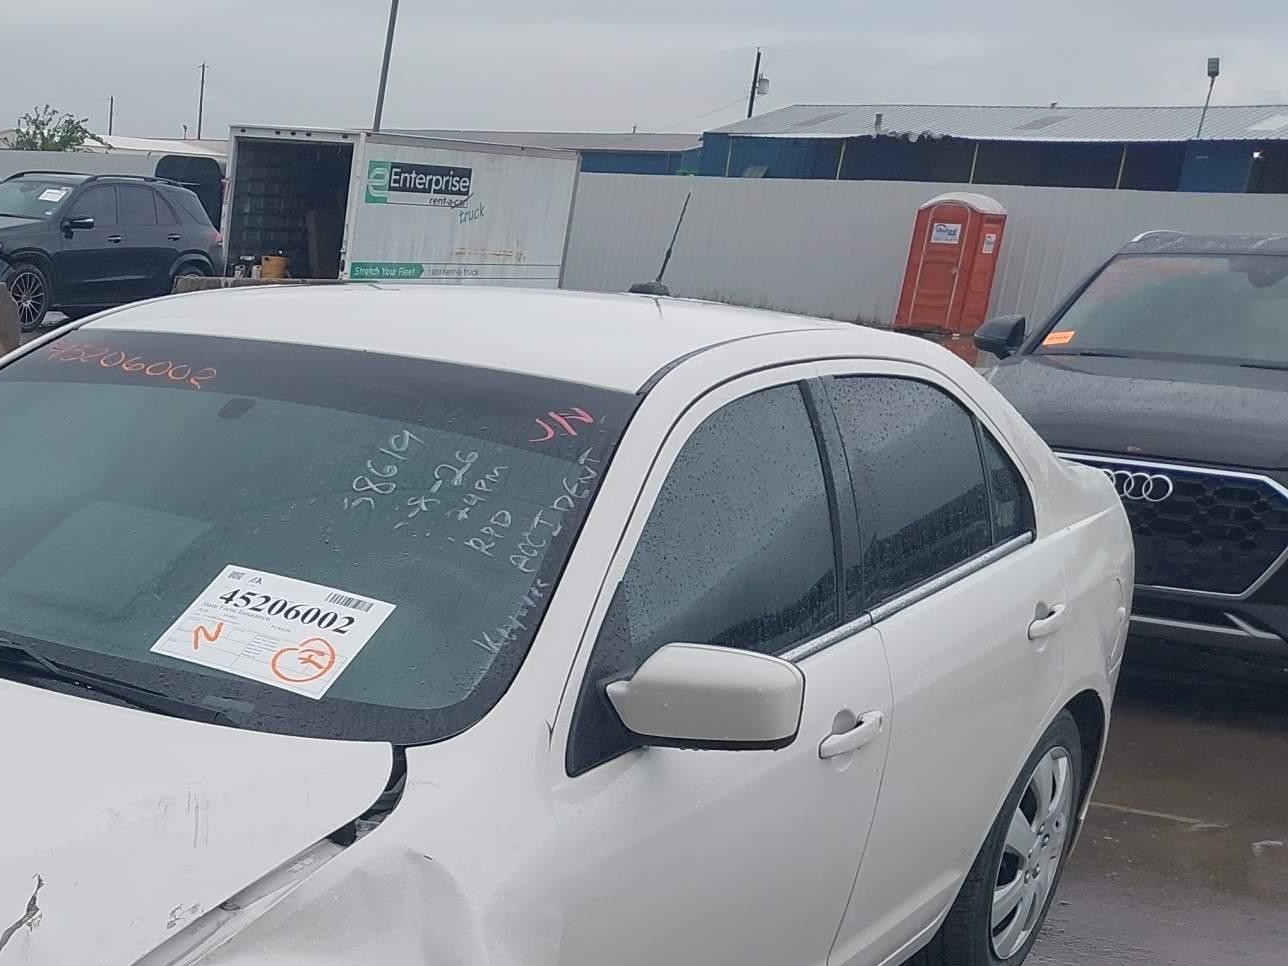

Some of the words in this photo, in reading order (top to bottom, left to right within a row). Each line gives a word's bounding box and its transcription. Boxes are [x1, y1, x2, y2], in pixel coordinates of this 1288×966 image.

[390, 168, 470, 194] Enterprise
[459, 202, 485, 224] truck
[354, 266, 380, 276] Stretch
[382, 267, 398, 277] Your
[399, 267, 416, 276] Fleet
[219, 589, 355, 634] 45206002
